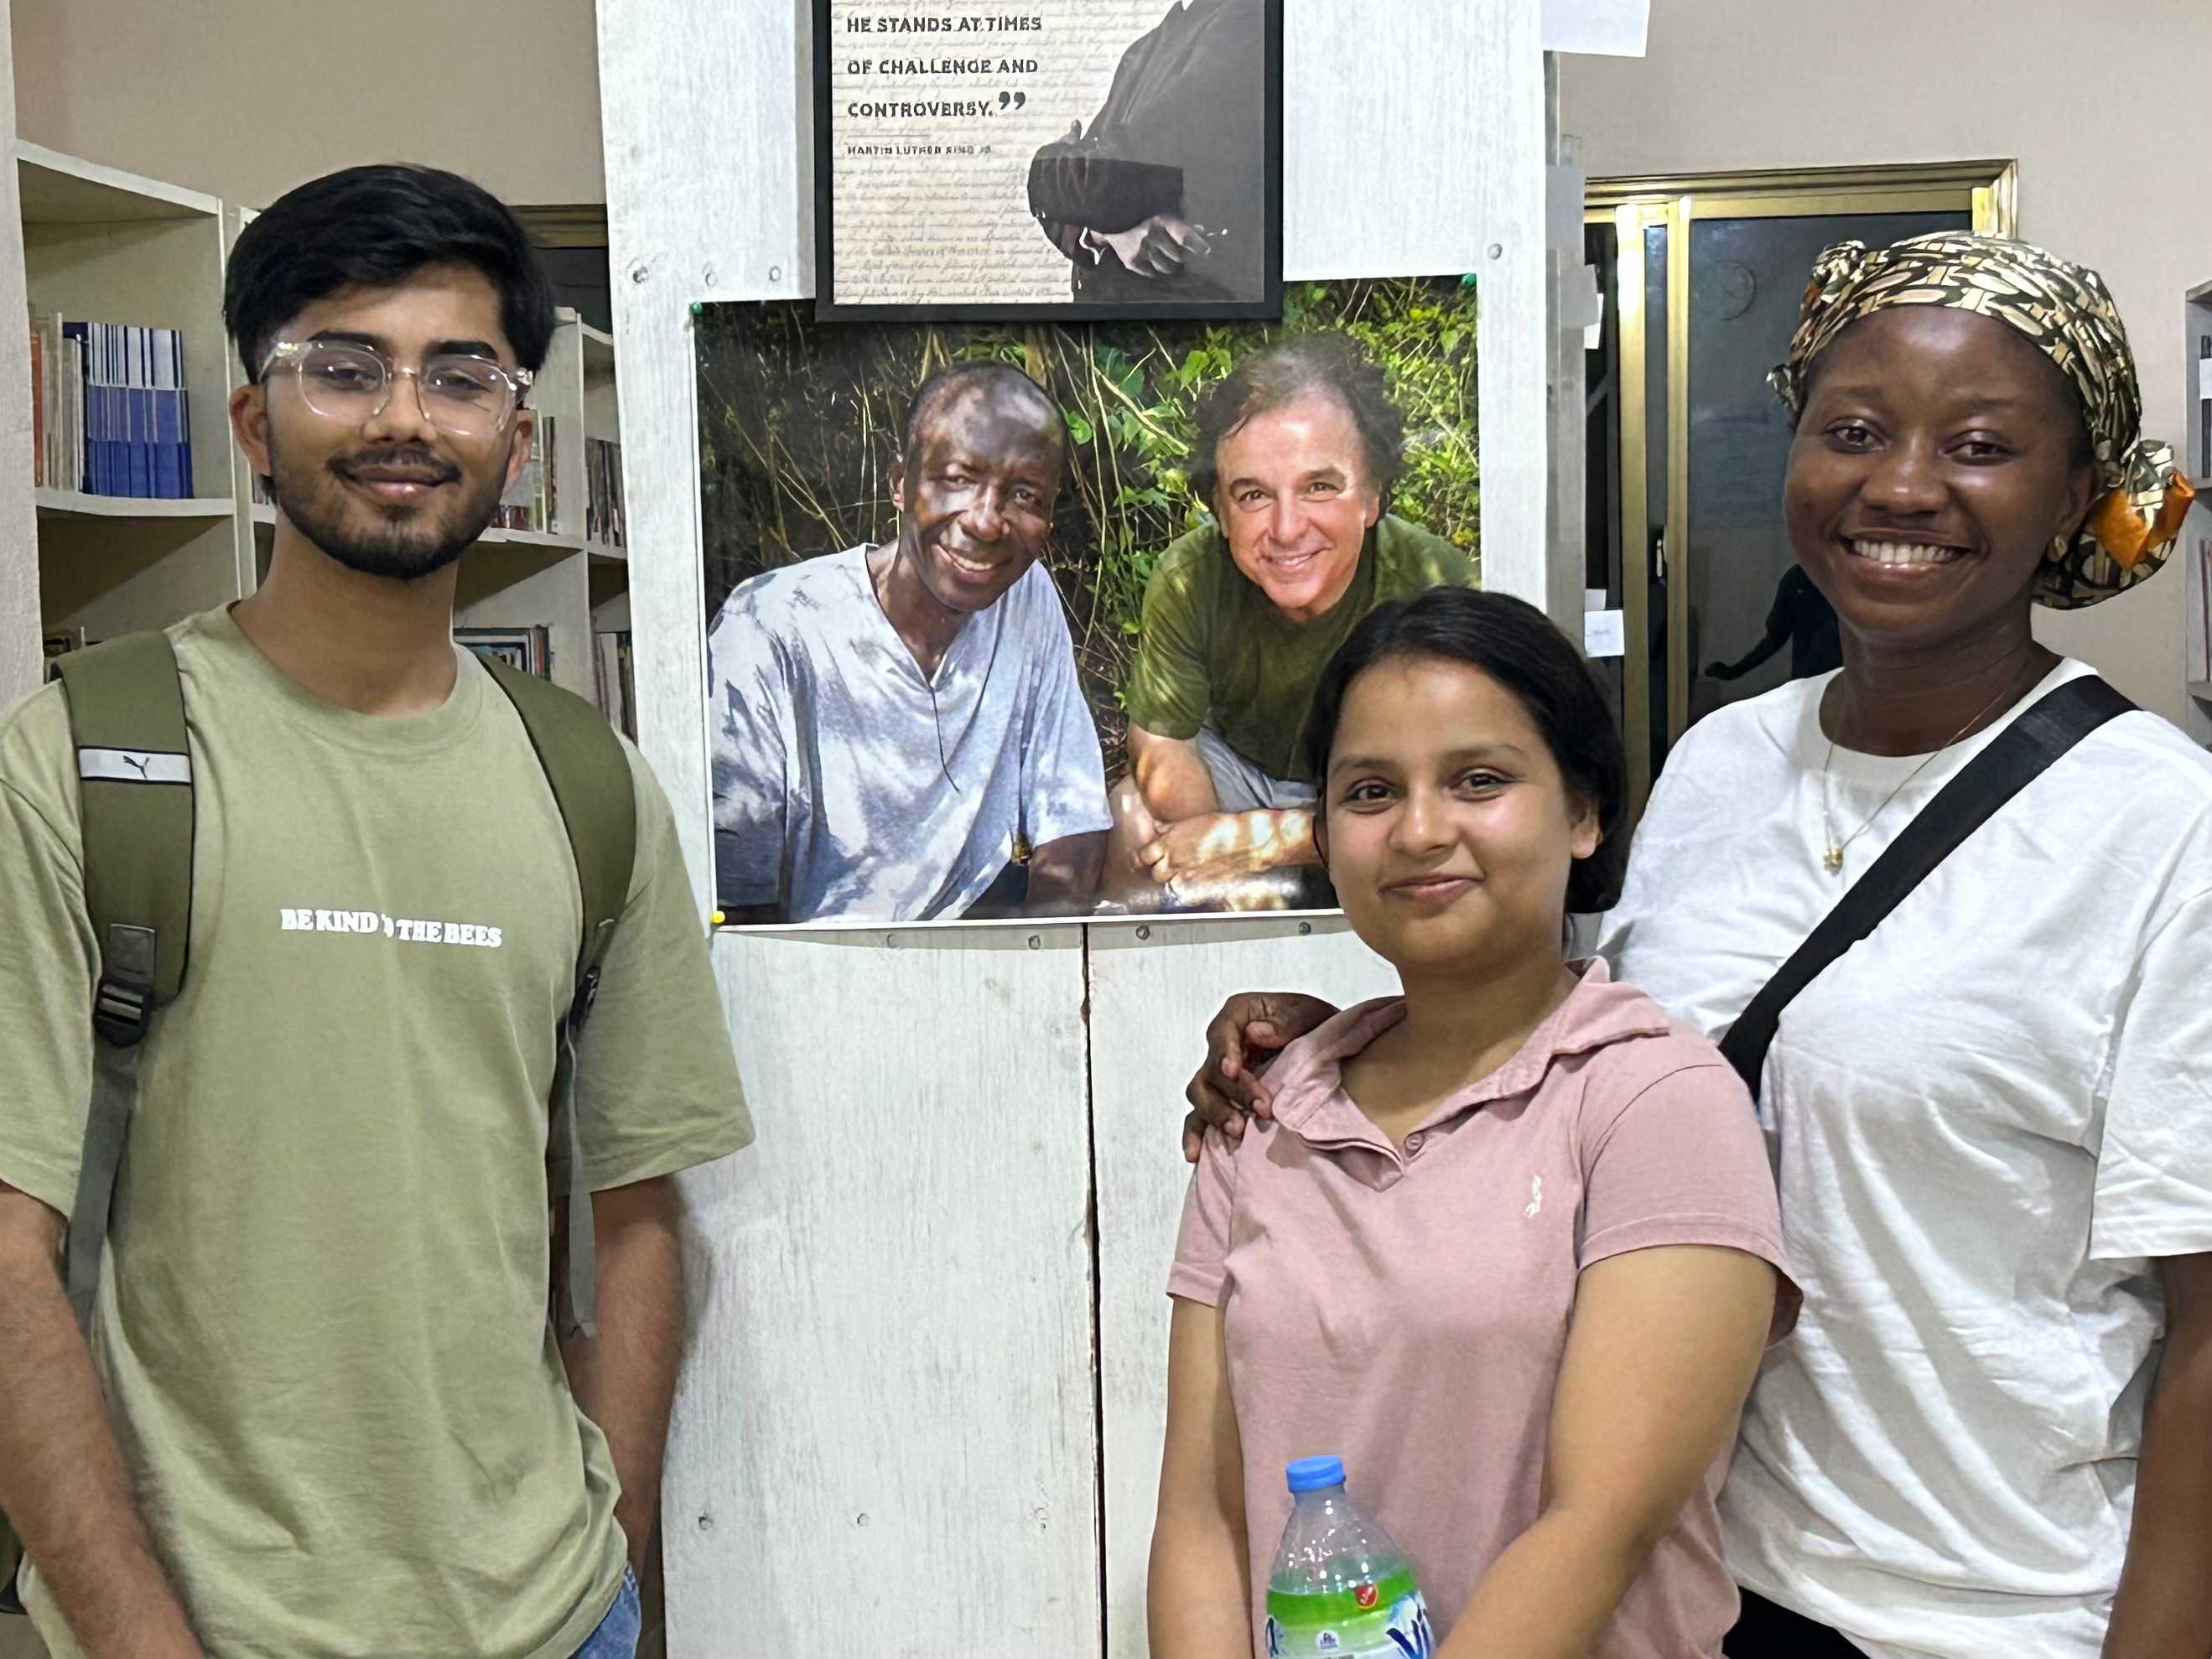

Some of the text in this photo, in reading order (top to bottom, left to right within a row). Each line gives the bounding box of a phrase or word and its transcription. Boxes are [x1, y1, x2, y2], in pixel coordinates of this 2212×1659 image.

[847, 15, 1042, 33] HE STANDS AT TIMES
[847, 59, 1039, 75] OF CHALLENGE AND
[280, 909, 314, 931] BE
[315, 910, 379, 933] KIND
[396, 919, 443, 943] THE
[444, 922, 502, 948] BEES
